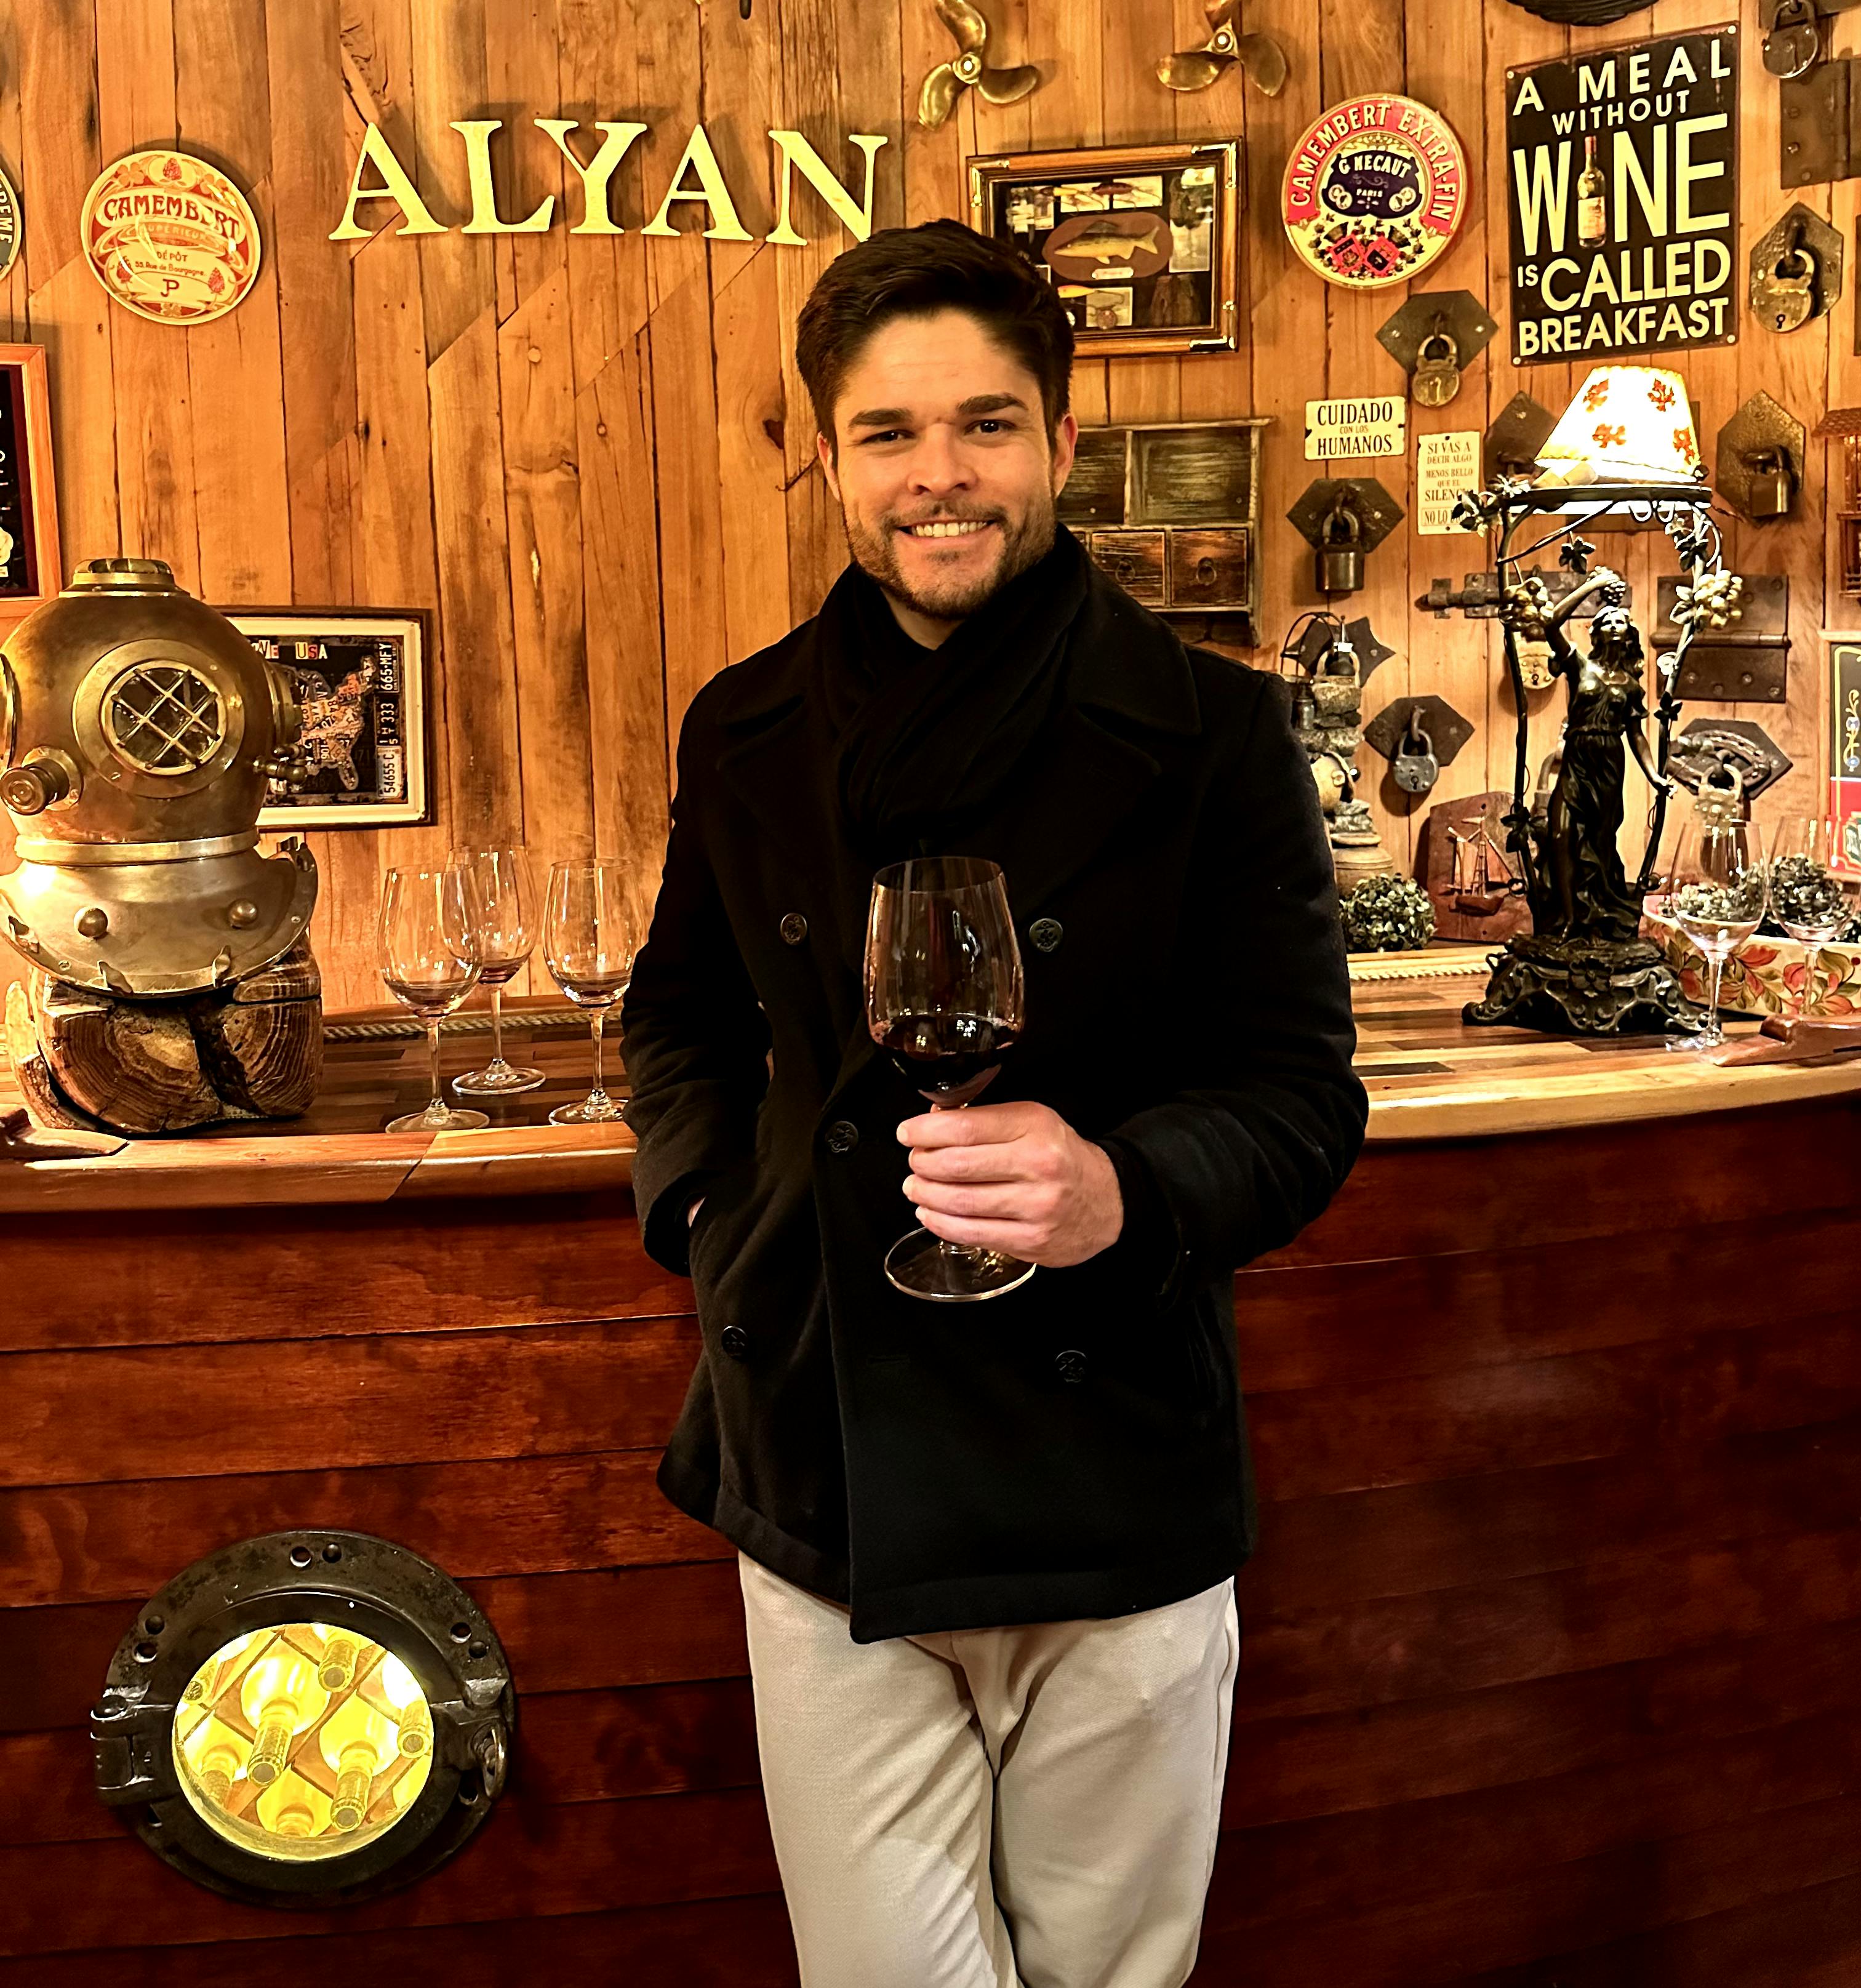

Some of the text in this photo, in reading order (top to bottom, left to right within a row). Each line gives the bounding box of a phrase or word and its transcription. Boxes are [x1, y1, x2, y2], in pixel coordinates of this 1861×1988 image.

[1513, 39, 1731, 116] A MEAL
[1552, 90, 1690, 135] WITHOUT
[1291, 103, 1391, 206] CAMEMBERT
[329, 119, 888, 246] ALYAN
[1356, 188, 1383, 198] PARIS
[1518, 239, 1731, 311] IS CALLED
[1519, 297, 1729, 356] BREAKFAST
[1318, 401, 1393, 426] CUIDADO
[1340, 425, 1369, 435] CON LOS
[1318, 434, 1392, 455] HUMANOS
[1428, 442, 1471, 454] SI VAS A
[1427, 455, 1471, 464] DECIR ALGO
[1426, 468, 1473, 478] MENOS BELLO
[1438, 480, 1449, 488] QUE
[1425, 510, 1435, 524] NO
[1438, 510, 1448, 524] LO
[295, 642, 328, 660] USA
[381, 703, 394, 723] 333
